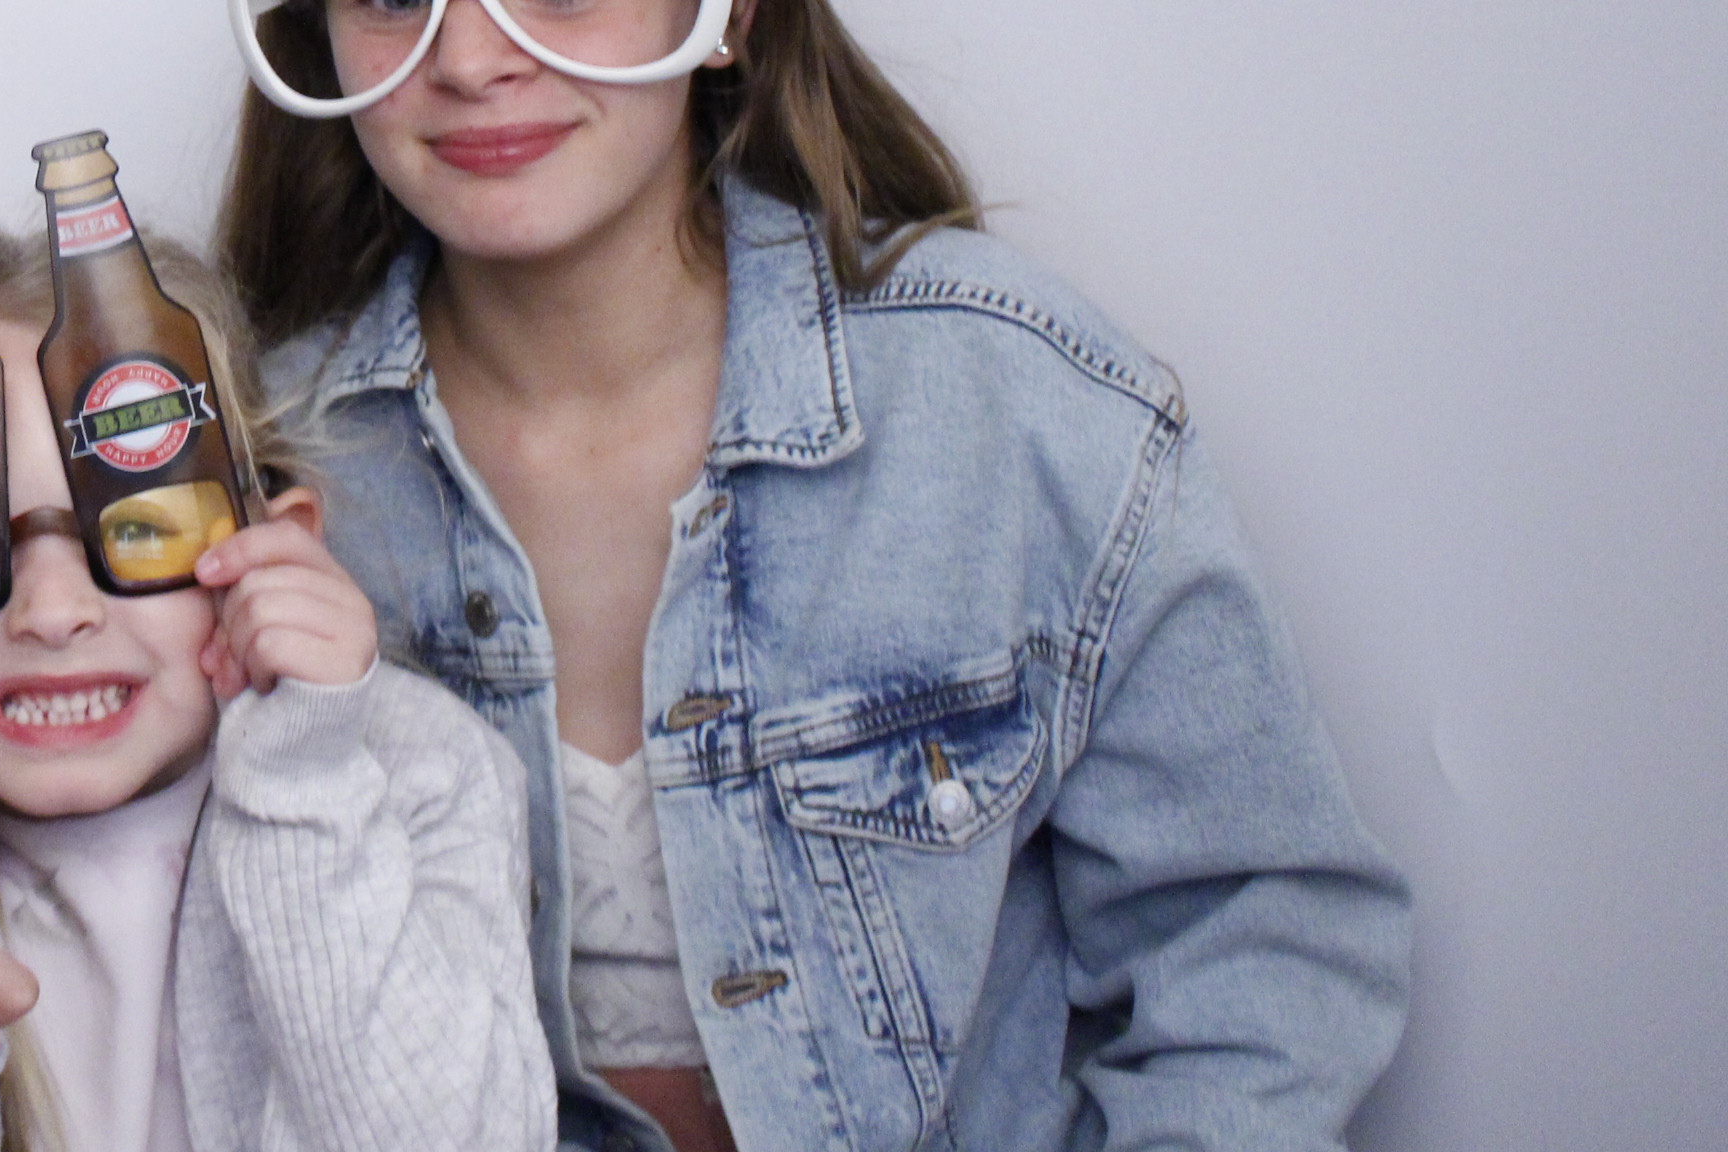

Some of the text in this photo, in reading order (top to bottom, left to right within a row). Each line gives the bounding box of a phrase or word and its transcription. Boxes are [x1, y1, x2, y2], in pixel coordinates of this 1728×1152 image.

[57, 211, 120, 242] BEER
[93, 394, 186, 438] BEER
[105, 445, 147, 465] HAPPY
